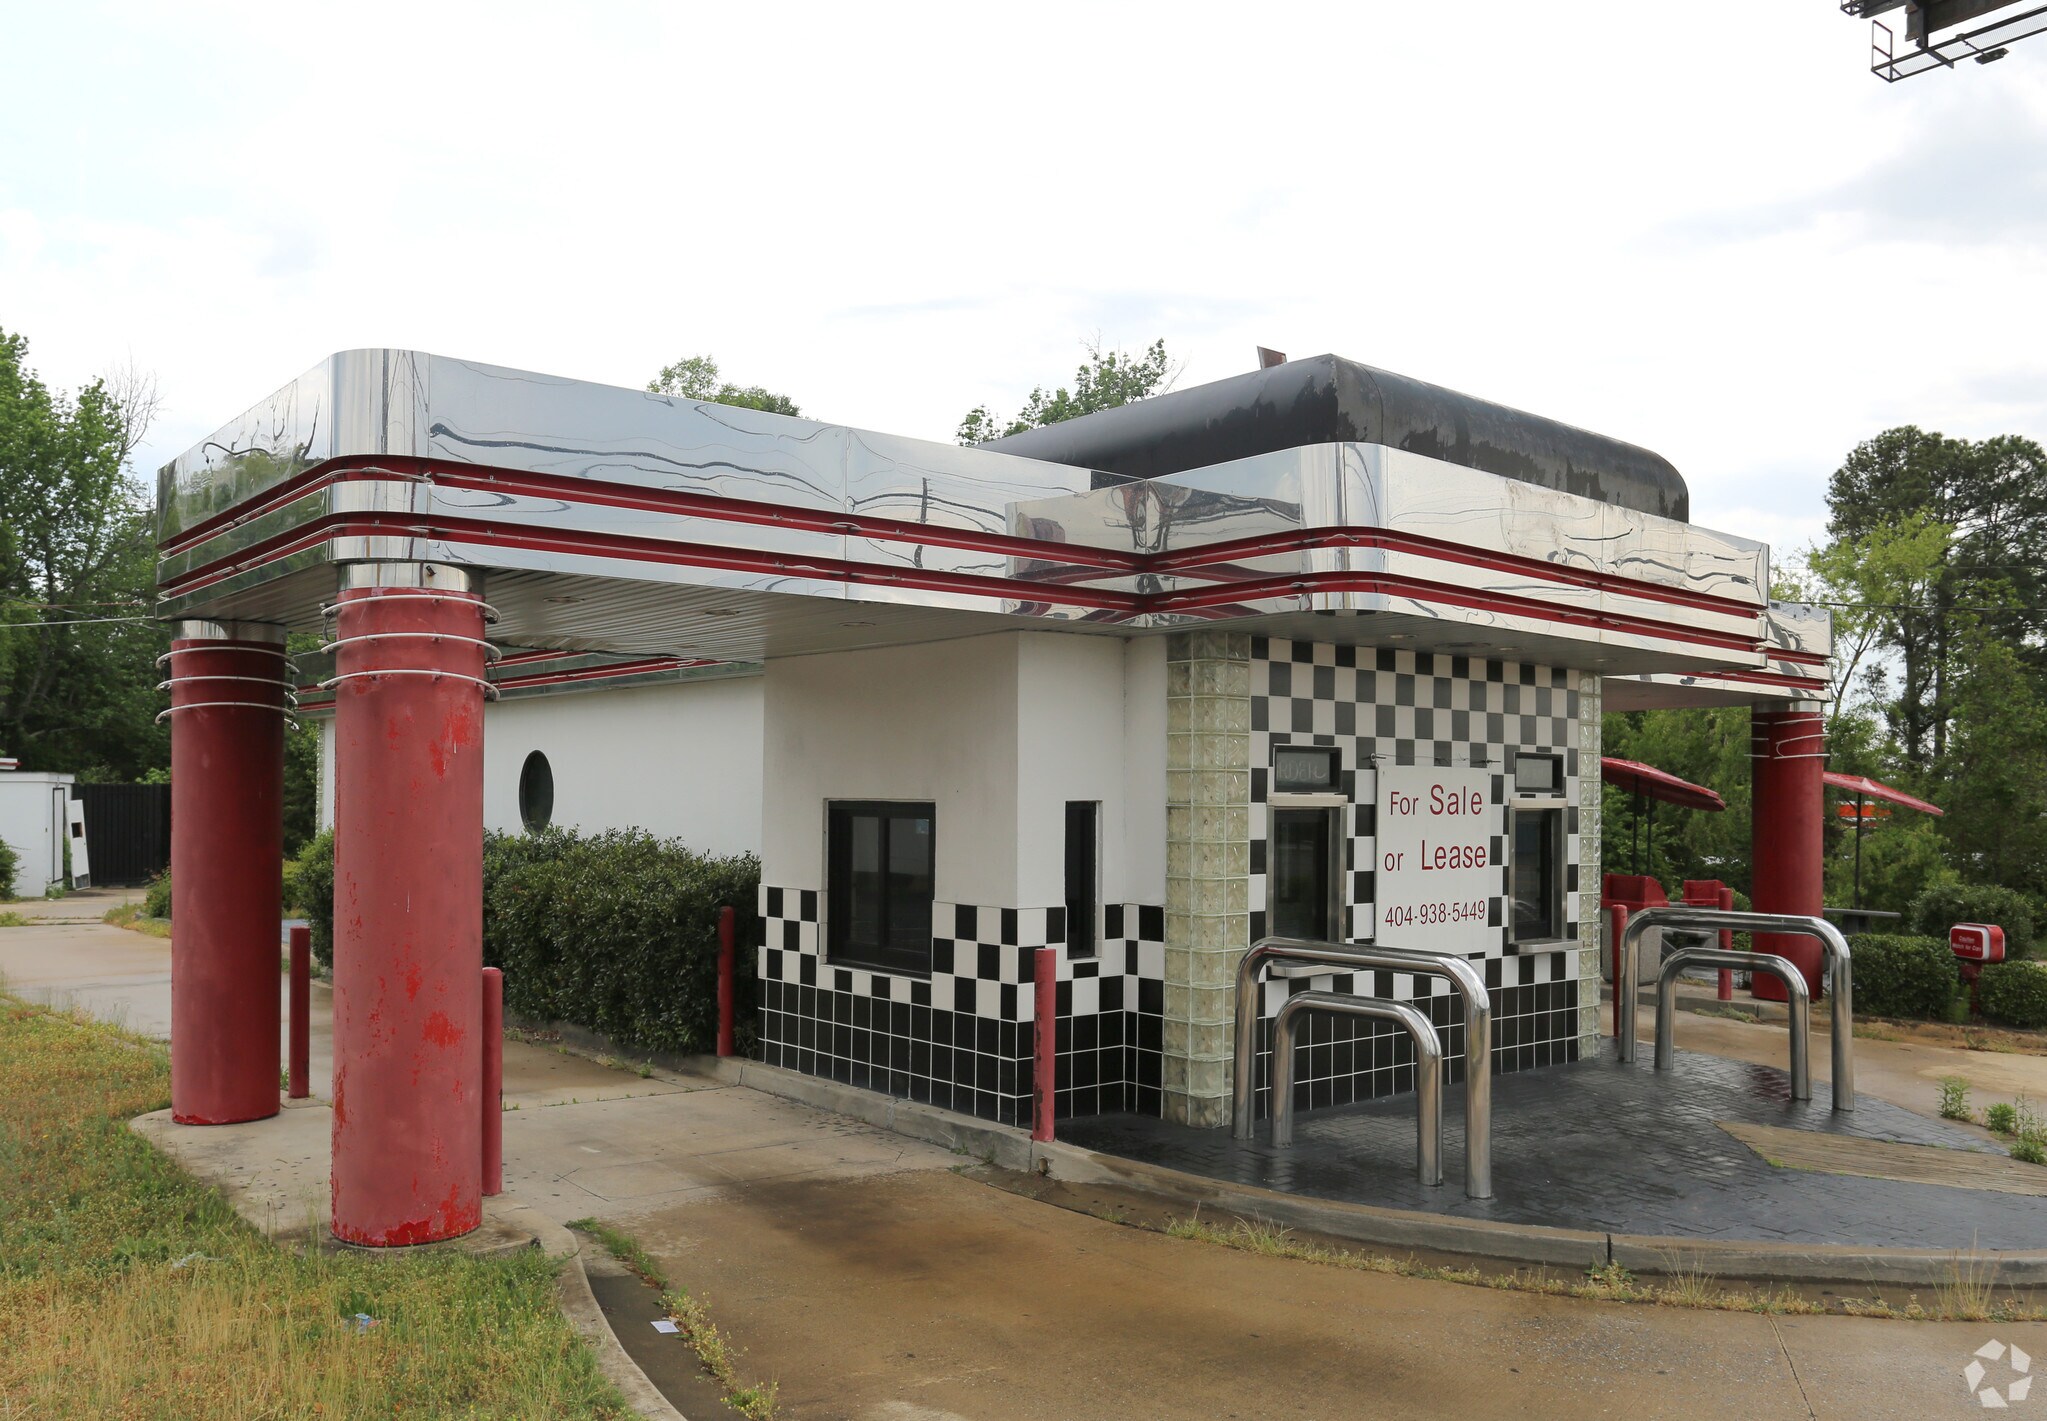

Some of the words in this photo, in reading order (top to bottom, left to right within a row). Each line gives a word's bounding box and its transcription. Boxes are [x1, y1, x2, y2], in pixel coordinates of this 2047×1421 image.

[1390, 791, 1419, 816] For
[1429, 784, 1483, 816] Sale
[1384, 852, 1404, 871] or
[1421, 839, 1487, 870] Lease
[1384, 900, 1486, 927] 404-938-5449
